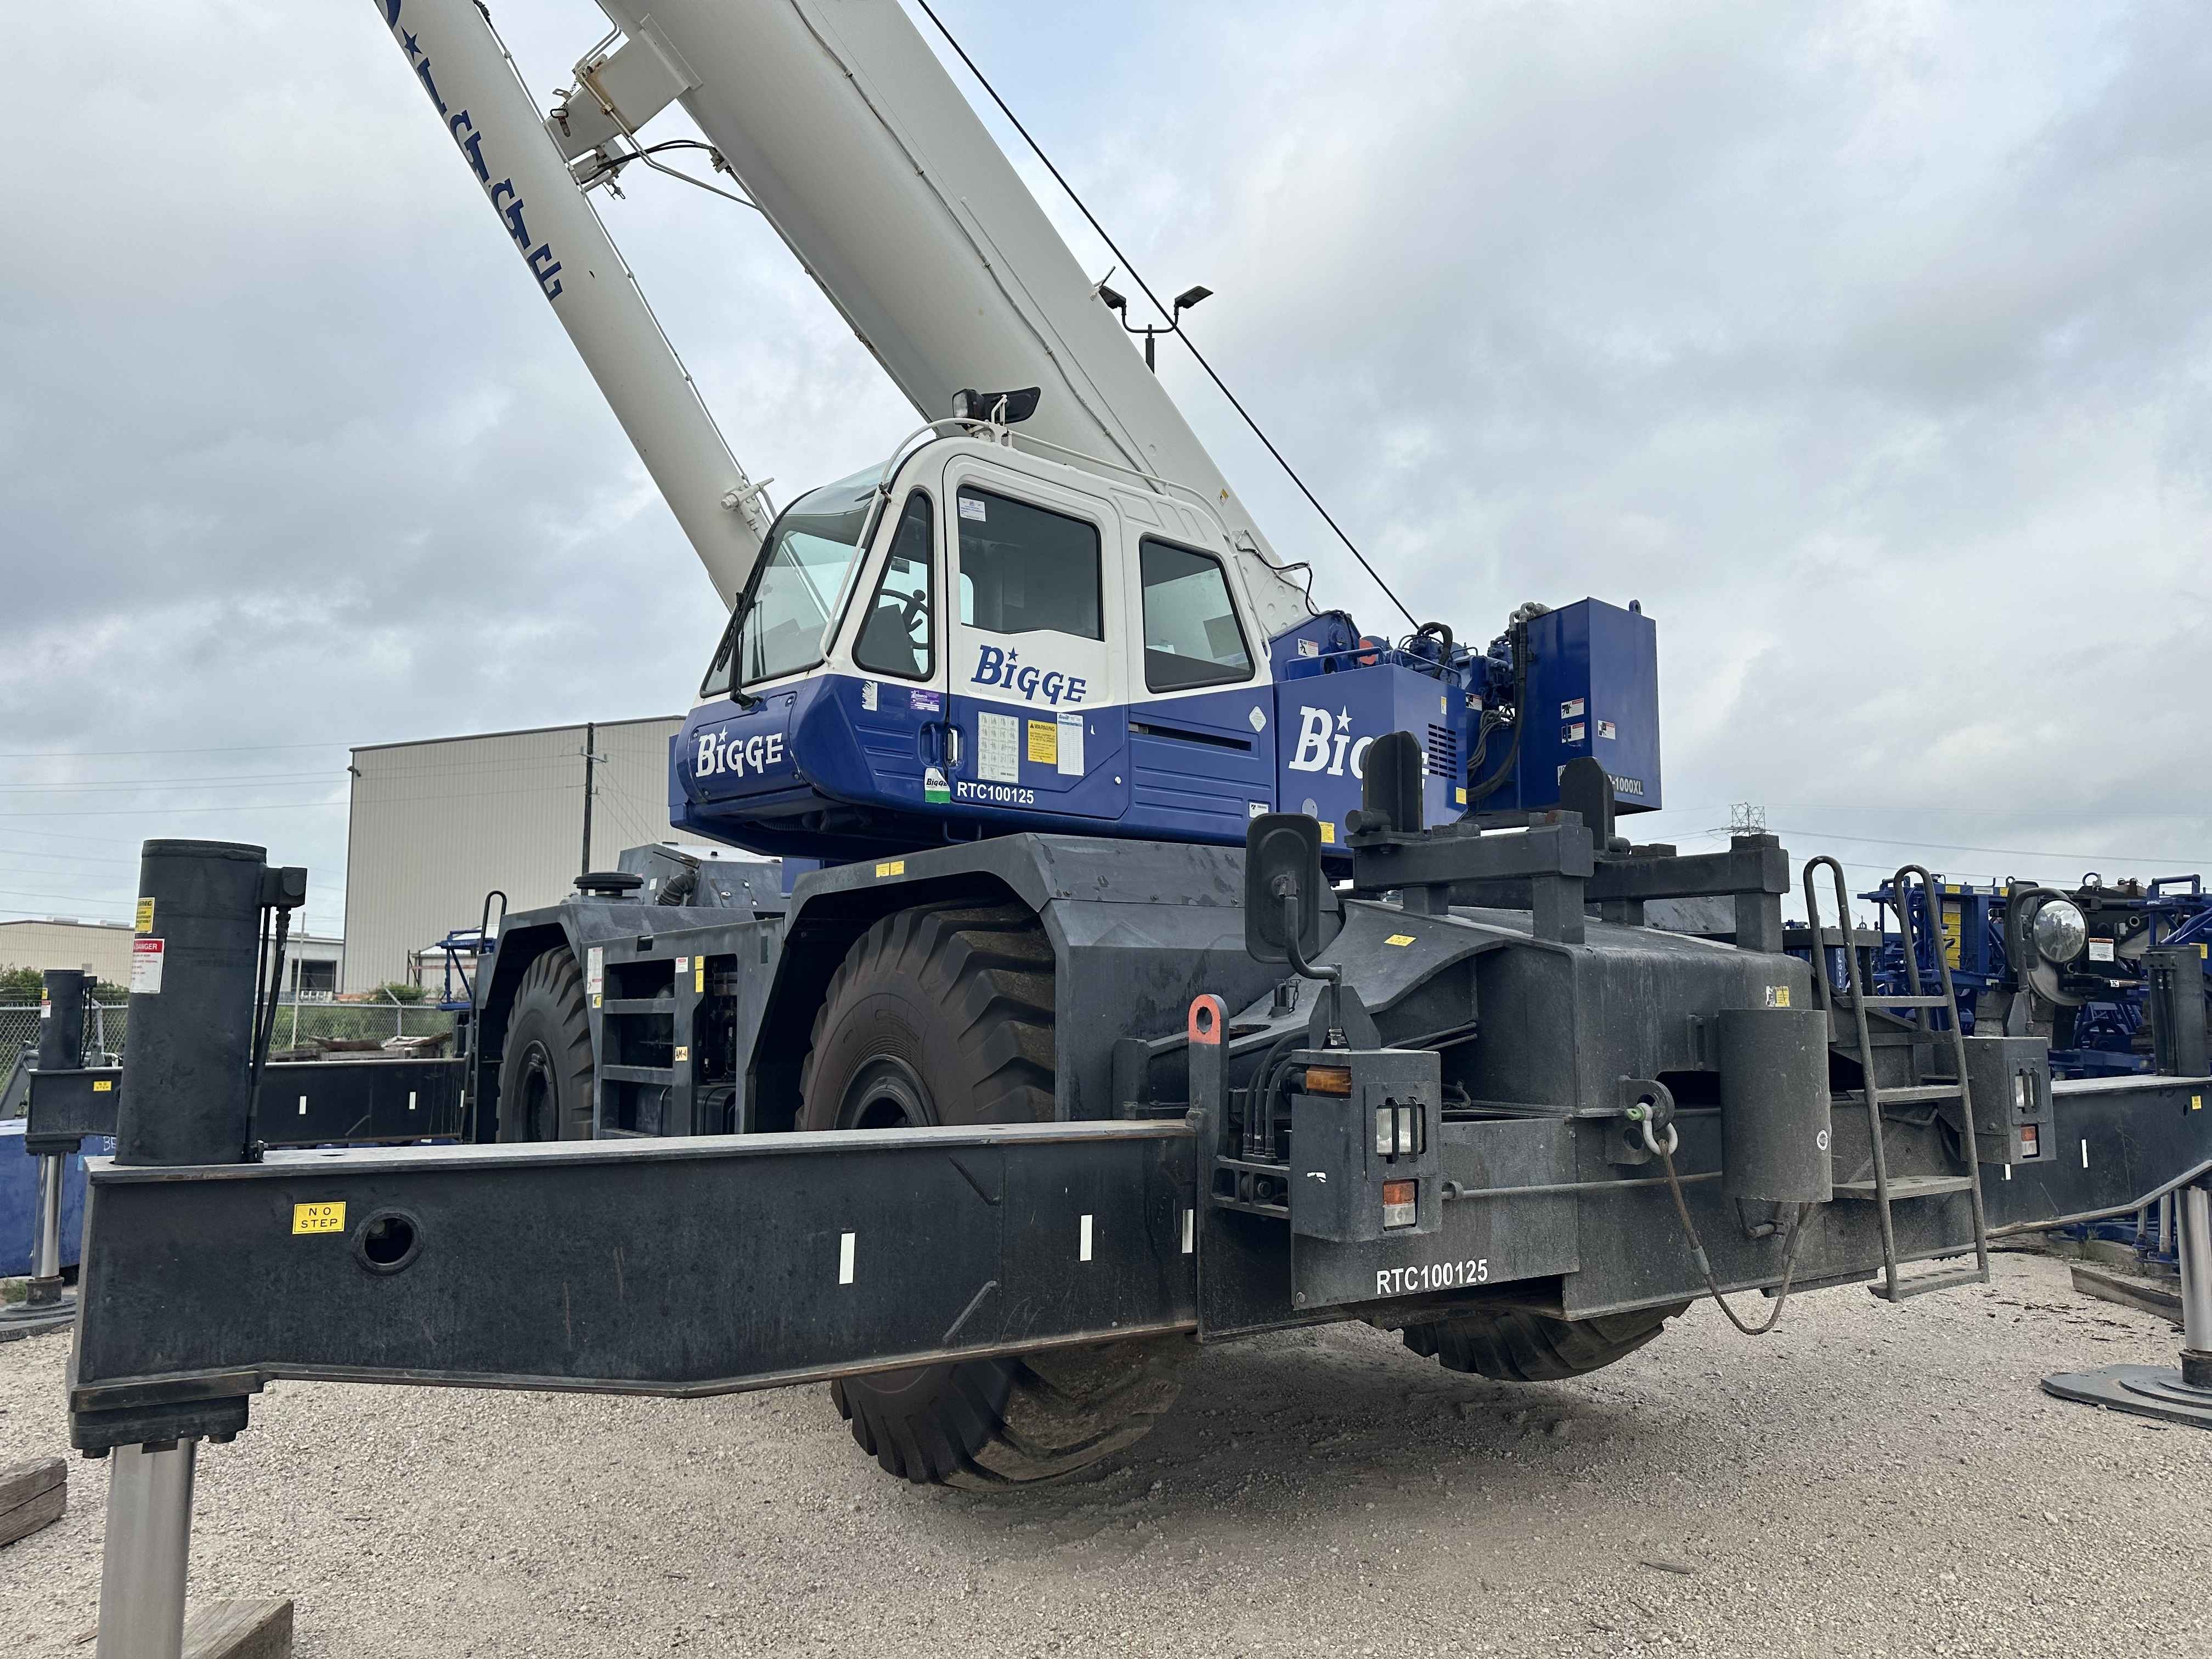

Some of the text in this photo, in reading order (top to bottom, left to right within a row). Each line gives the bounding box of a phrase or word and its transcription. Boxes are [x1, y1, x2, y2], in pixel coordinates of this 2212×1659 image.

[970, 644, 1086, 705] BIGGE
[696, 725, 783, 777] BIGGE
[957, 781, 1035, 804] RTC100125
[301, 1218, 338, 1228] STEP
[309, 1207, 331, 1216] NO
[1376, 1259, 1488, 1295] RTC100125
